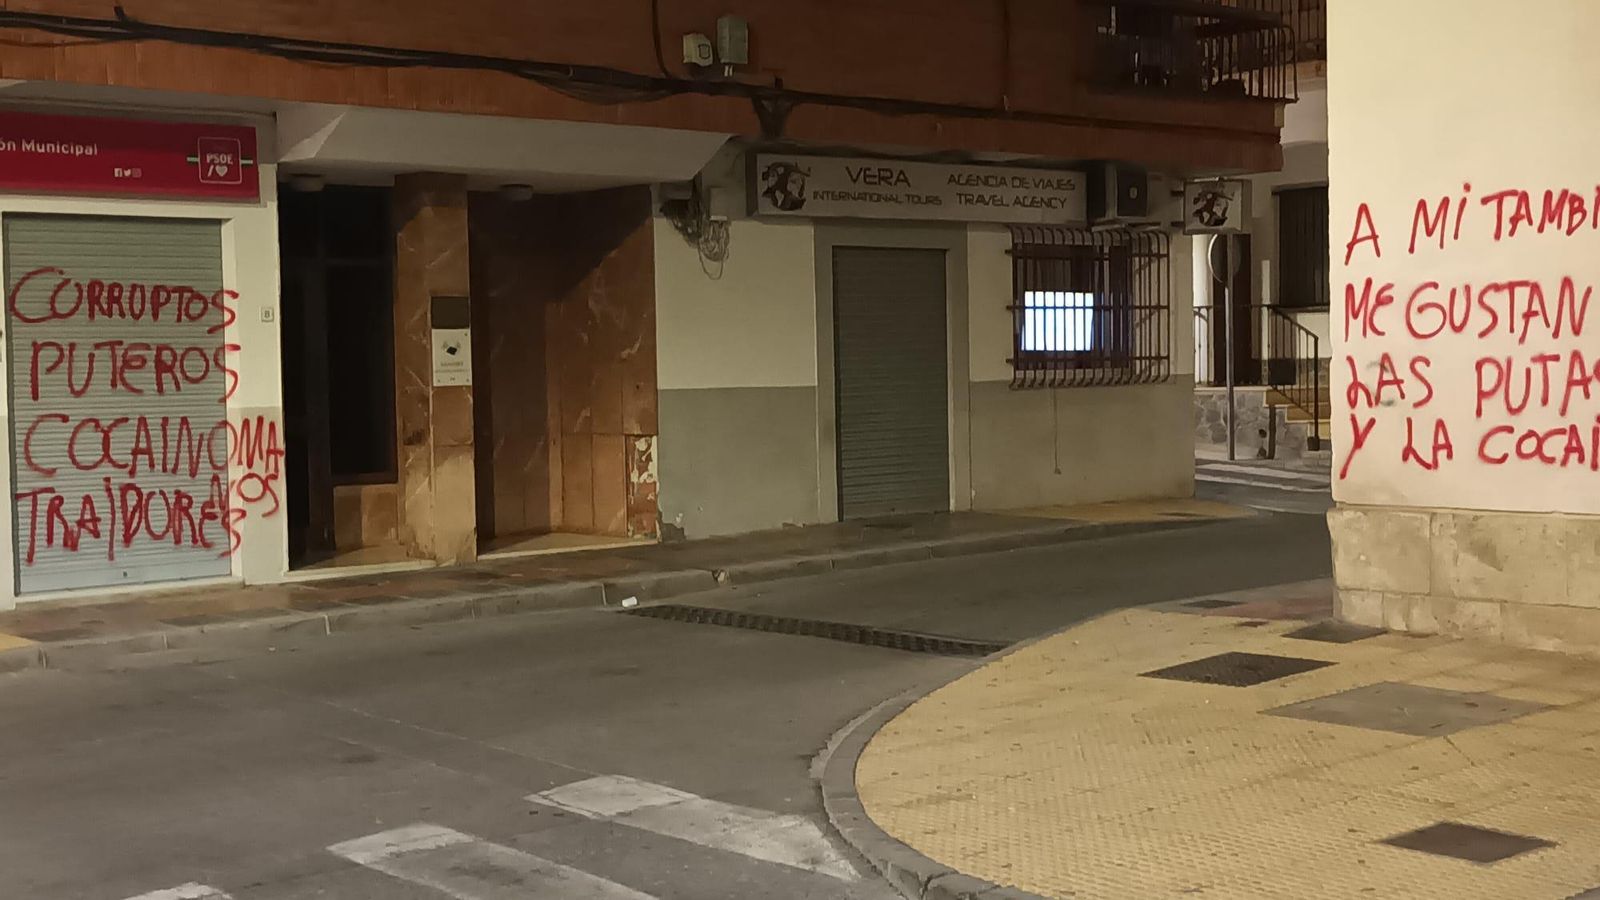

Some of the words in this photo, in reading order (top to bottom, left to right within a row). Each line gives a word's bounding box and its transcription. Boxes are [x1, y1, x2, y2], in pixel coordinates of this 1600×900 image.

[21, 139, 98, 156] Municipal
[206, 153, 233, 165] PSOE
[845, 166, 911, 188] VERA
[947, 174, 1008, 188] AGENCIA
[1011, 176, 1030, 189] DE
[1032, 178, 1075, 191] VIAJES
[813, 190, 903, 204] INTERNATIONAL
[905, 193, 943, 206] TOURS
[956, 192, 1009, 207] TRAVEL
[1012, 196, 1067, 209] AGENCY
[1344, 203, 1381, 266] A
[9, 266, 240, 335] CORRUPTOS
[31, 339, 241, 403] PUTEROS
[1346, 352, 1434, 409] LAS
[1475, 349, 1600, 419] PUTA
[1339, 413, 1377, 480] Y
[1402, 416, 1454, 470] LA
